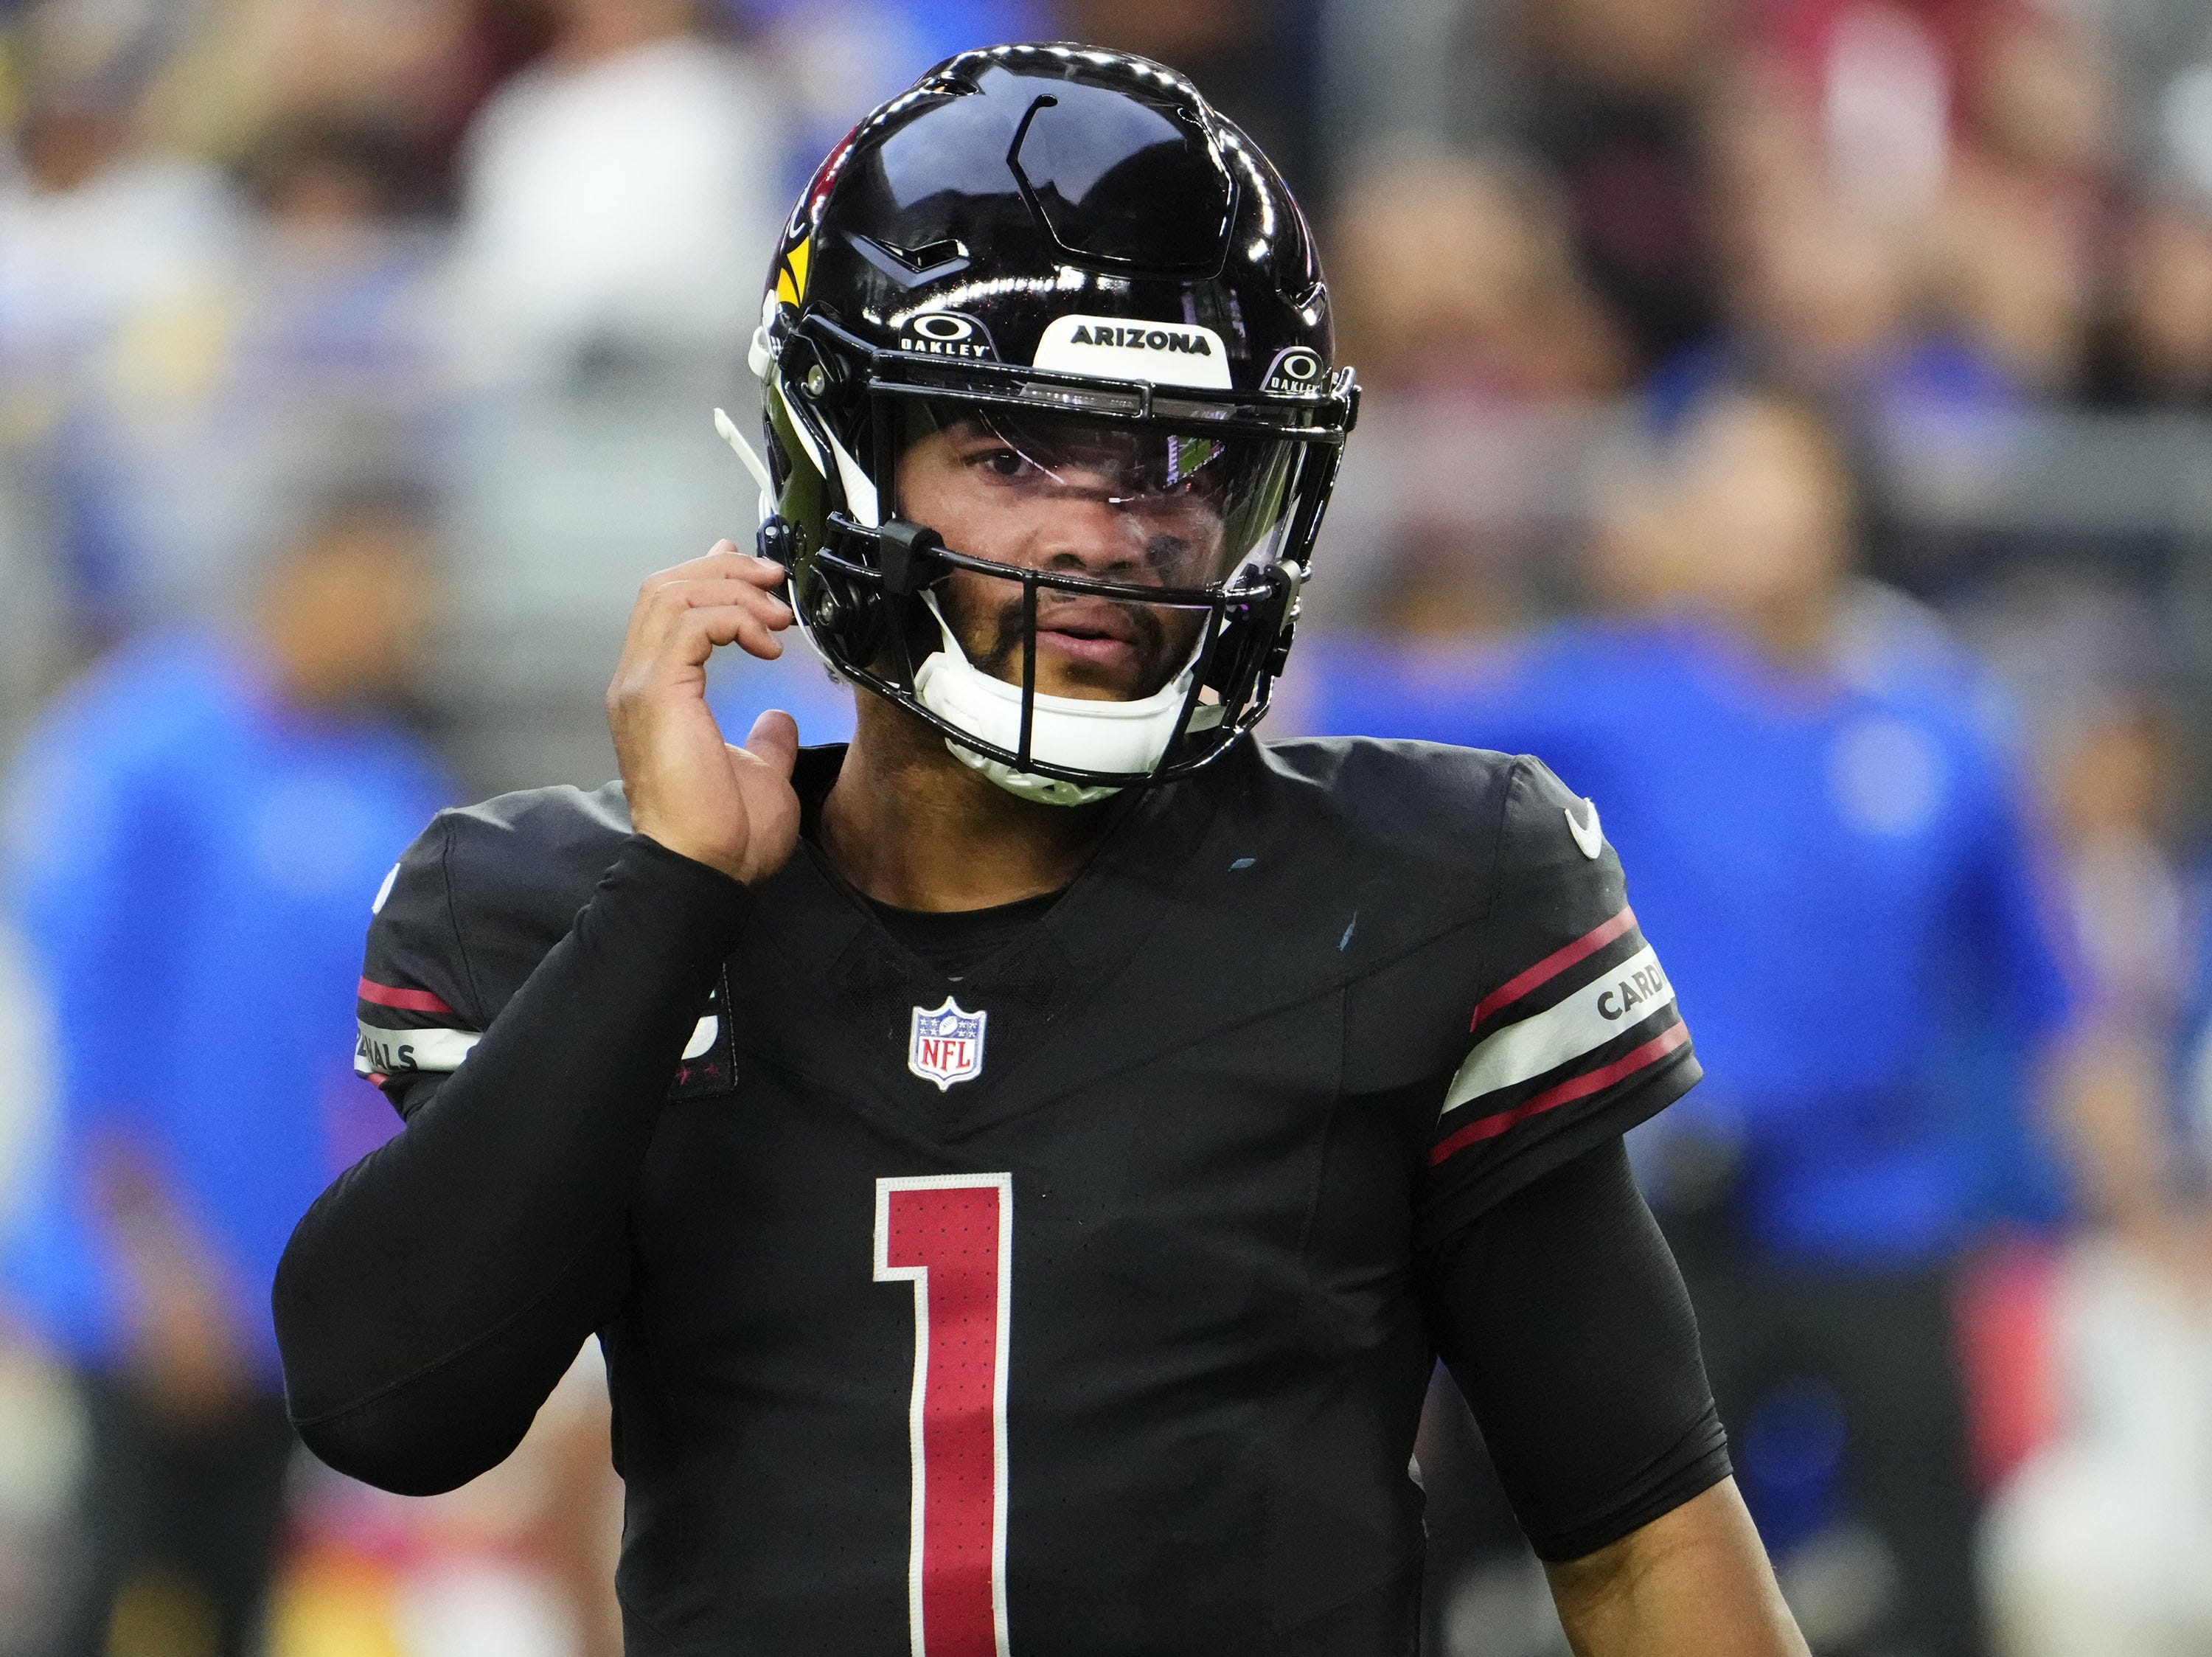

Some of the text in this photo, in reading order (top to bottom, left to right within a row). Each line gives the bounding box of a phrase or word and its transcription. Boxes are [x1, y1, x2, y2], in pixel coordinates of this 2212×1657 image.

[901, 338, 986, 357] OAKLEY
[1071, 325, 1211, 356] ARIZONA
[922, 1038, 970, 1072] NFL
[874, 1173, 1012, 1657] 1
